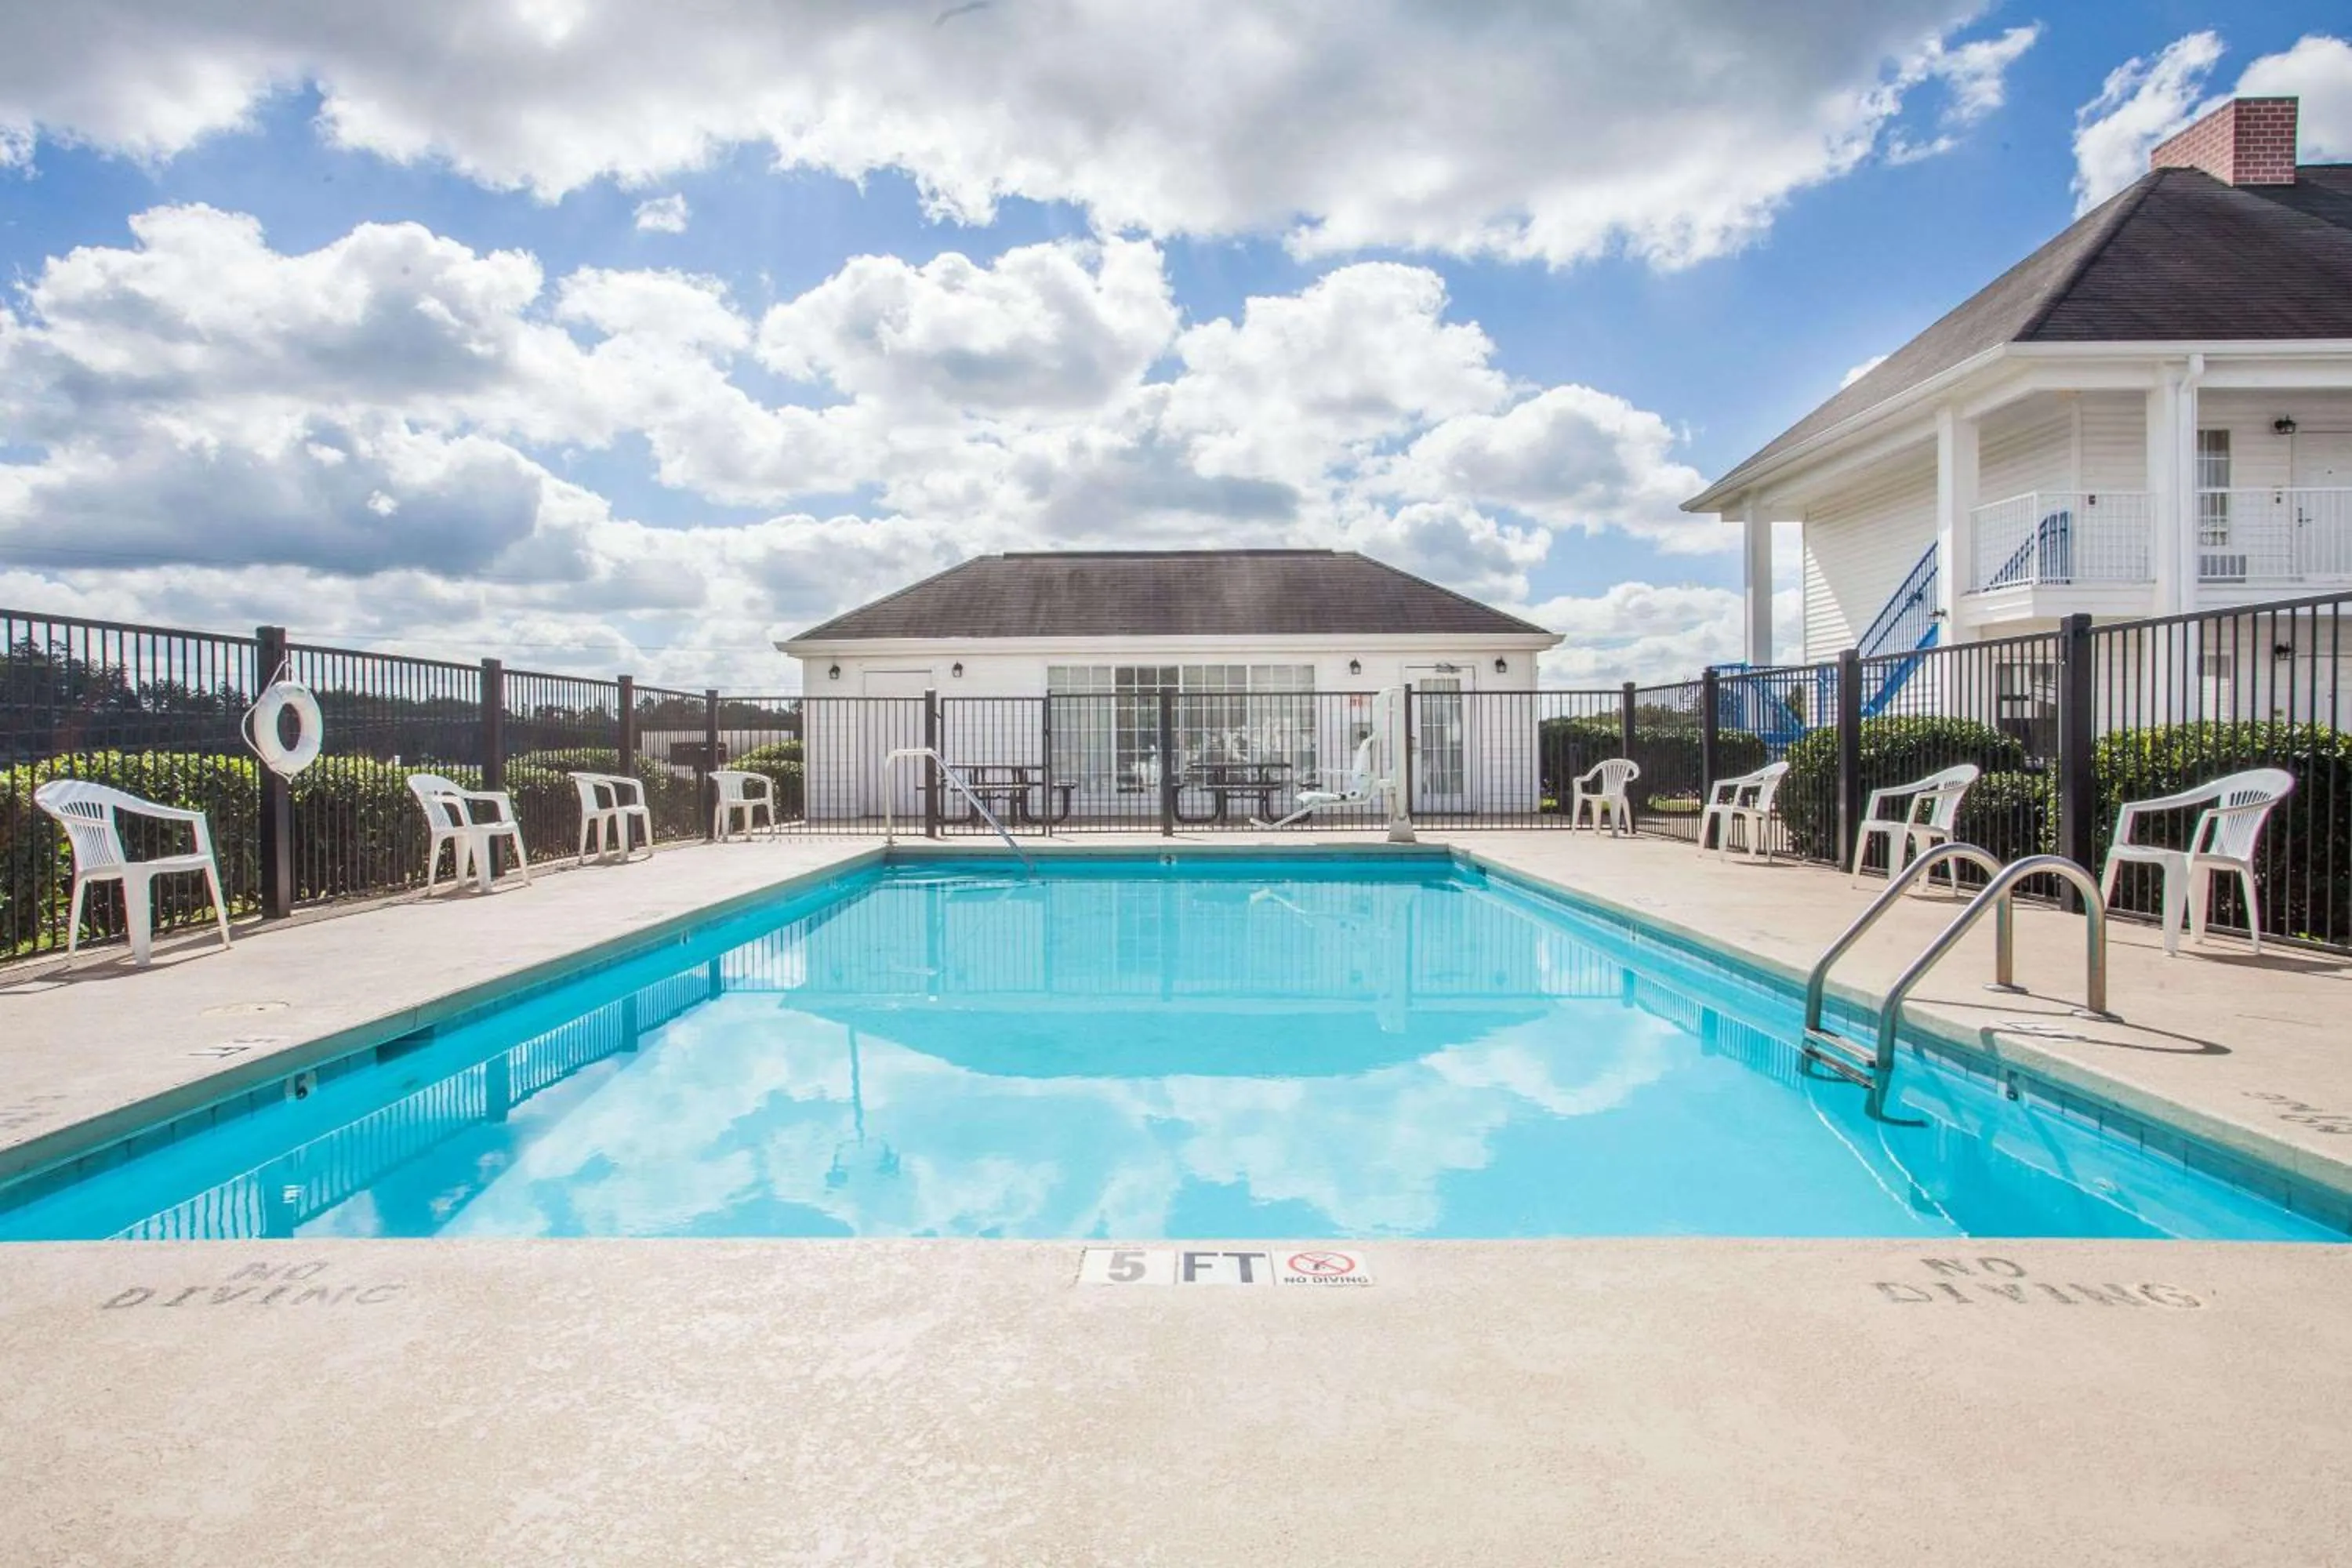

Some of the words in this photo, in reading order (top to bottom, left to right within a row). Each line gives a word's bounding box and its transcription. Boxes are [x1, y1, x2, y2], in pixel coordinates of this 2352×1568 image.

[1108, 1251, 1147, 1282] 5
[1183, 1252, 1265, 1283] FT
[1919, 1258, 2029, 1278] NO
